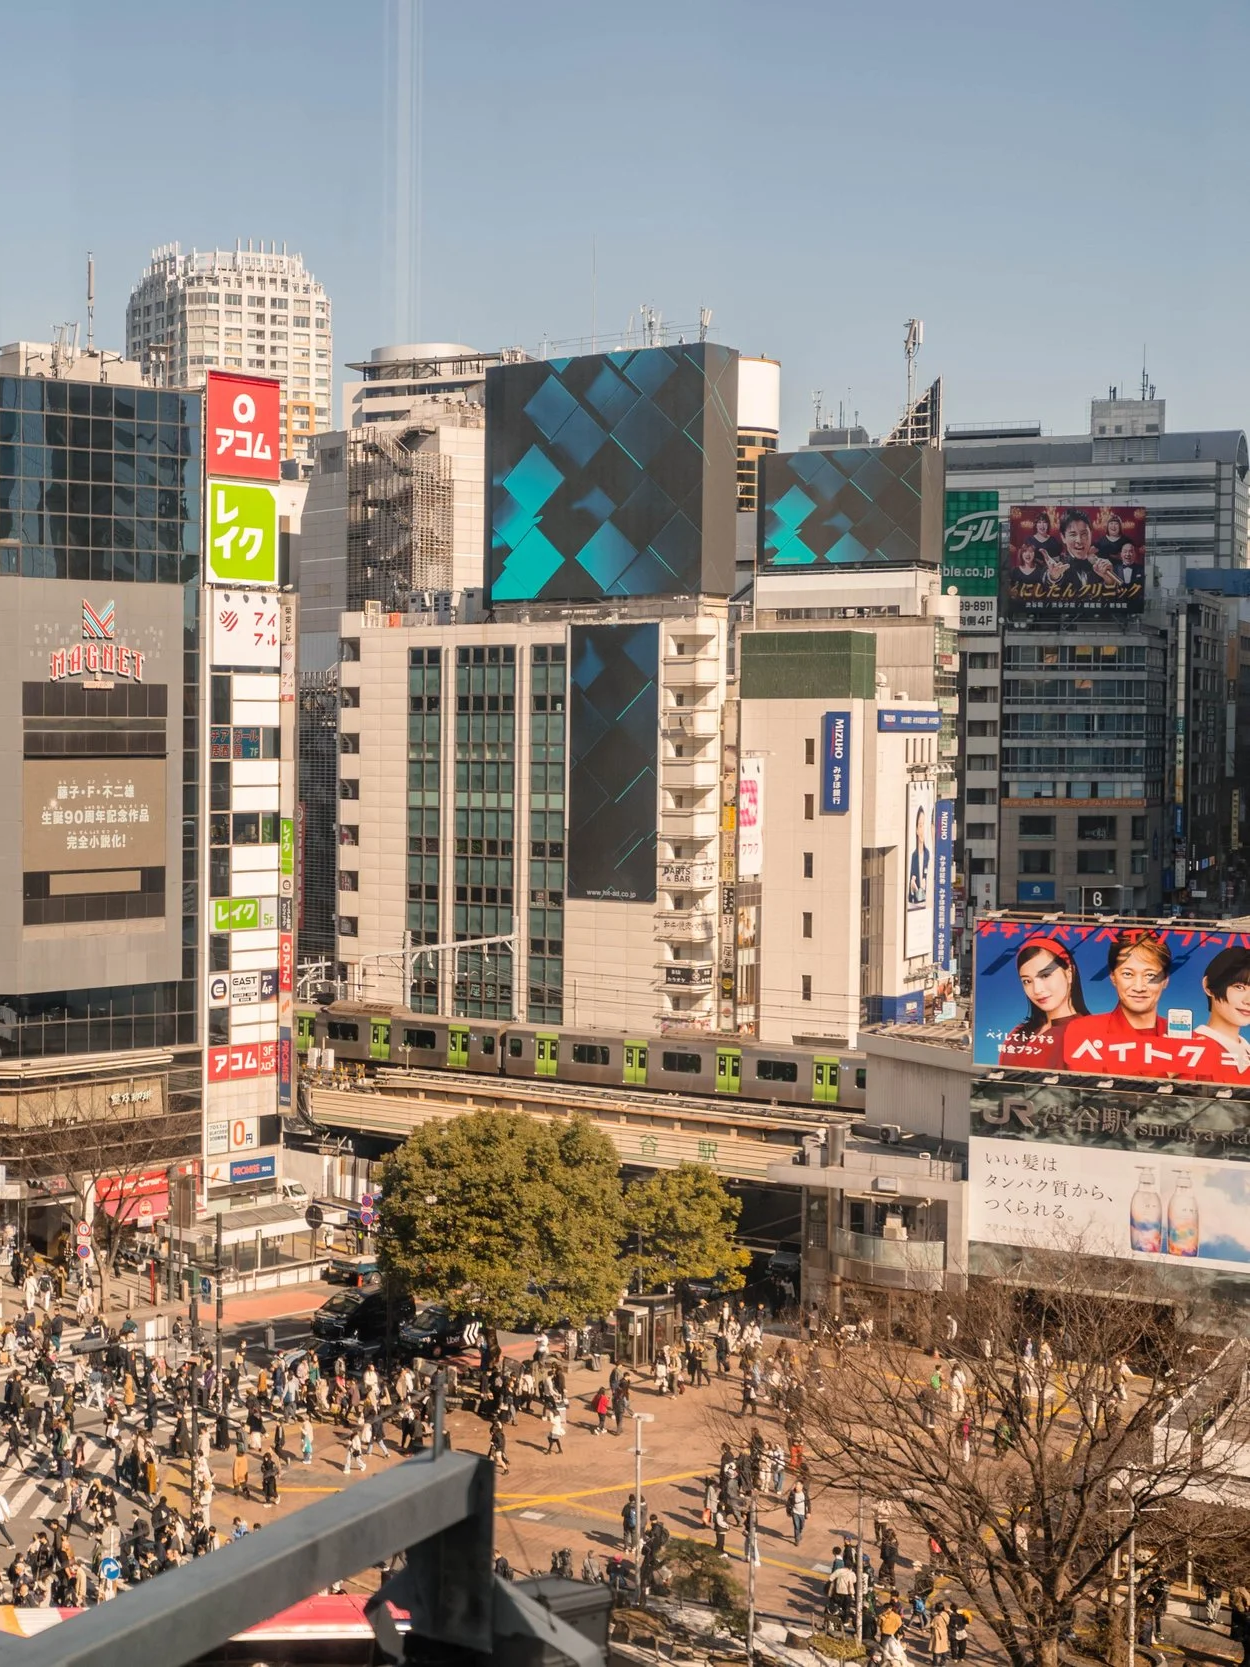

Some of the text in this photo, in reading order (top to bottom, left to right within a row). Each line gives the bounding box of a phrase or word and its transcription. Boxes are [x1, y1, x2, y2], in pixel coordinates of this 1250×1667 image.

[215, 427, 272, 460] アコム
[50, 642, 146, 682] MAGNET
[835, 718, 845, 759] MIZUHO
[211, 744, 259, 757] 居酒屋 7F
[41, 809, 150, 825] 生誕90周年記念作品
[283, 824, 291, 852] レイク
[662, 866, 691, 876] DARTS
[674, 875, 691, 883] BAR
[218, 903, 256, 922] レイク
[263, 914, 275, 926] 5F
[282, 954, 290, 983] アコム
[233, 976, 258, 986] EAST
[262, 982, 273, 995] 4F
[263, 1045, 274, 1057] 3F
[1072, 1039, 1206, 1068] ペイトク
[215, 1052, 257, 1073] アコム
[281, 1041, 290, 1084] PROMISE
[982, 1098, 1035, 1128] JR
[1043, 1104, 1133, 1135] 渋谷駅
[1137, 1123, 1215, 1146] shibuya
[232, 1164, 260, 1177] PROMISE
[985, 1152, 1058, 1173] いい髪は
[985, 1174, 1114, 1203] タンパク質から、
[984, 1198, 1075, 1223] つくられる。
